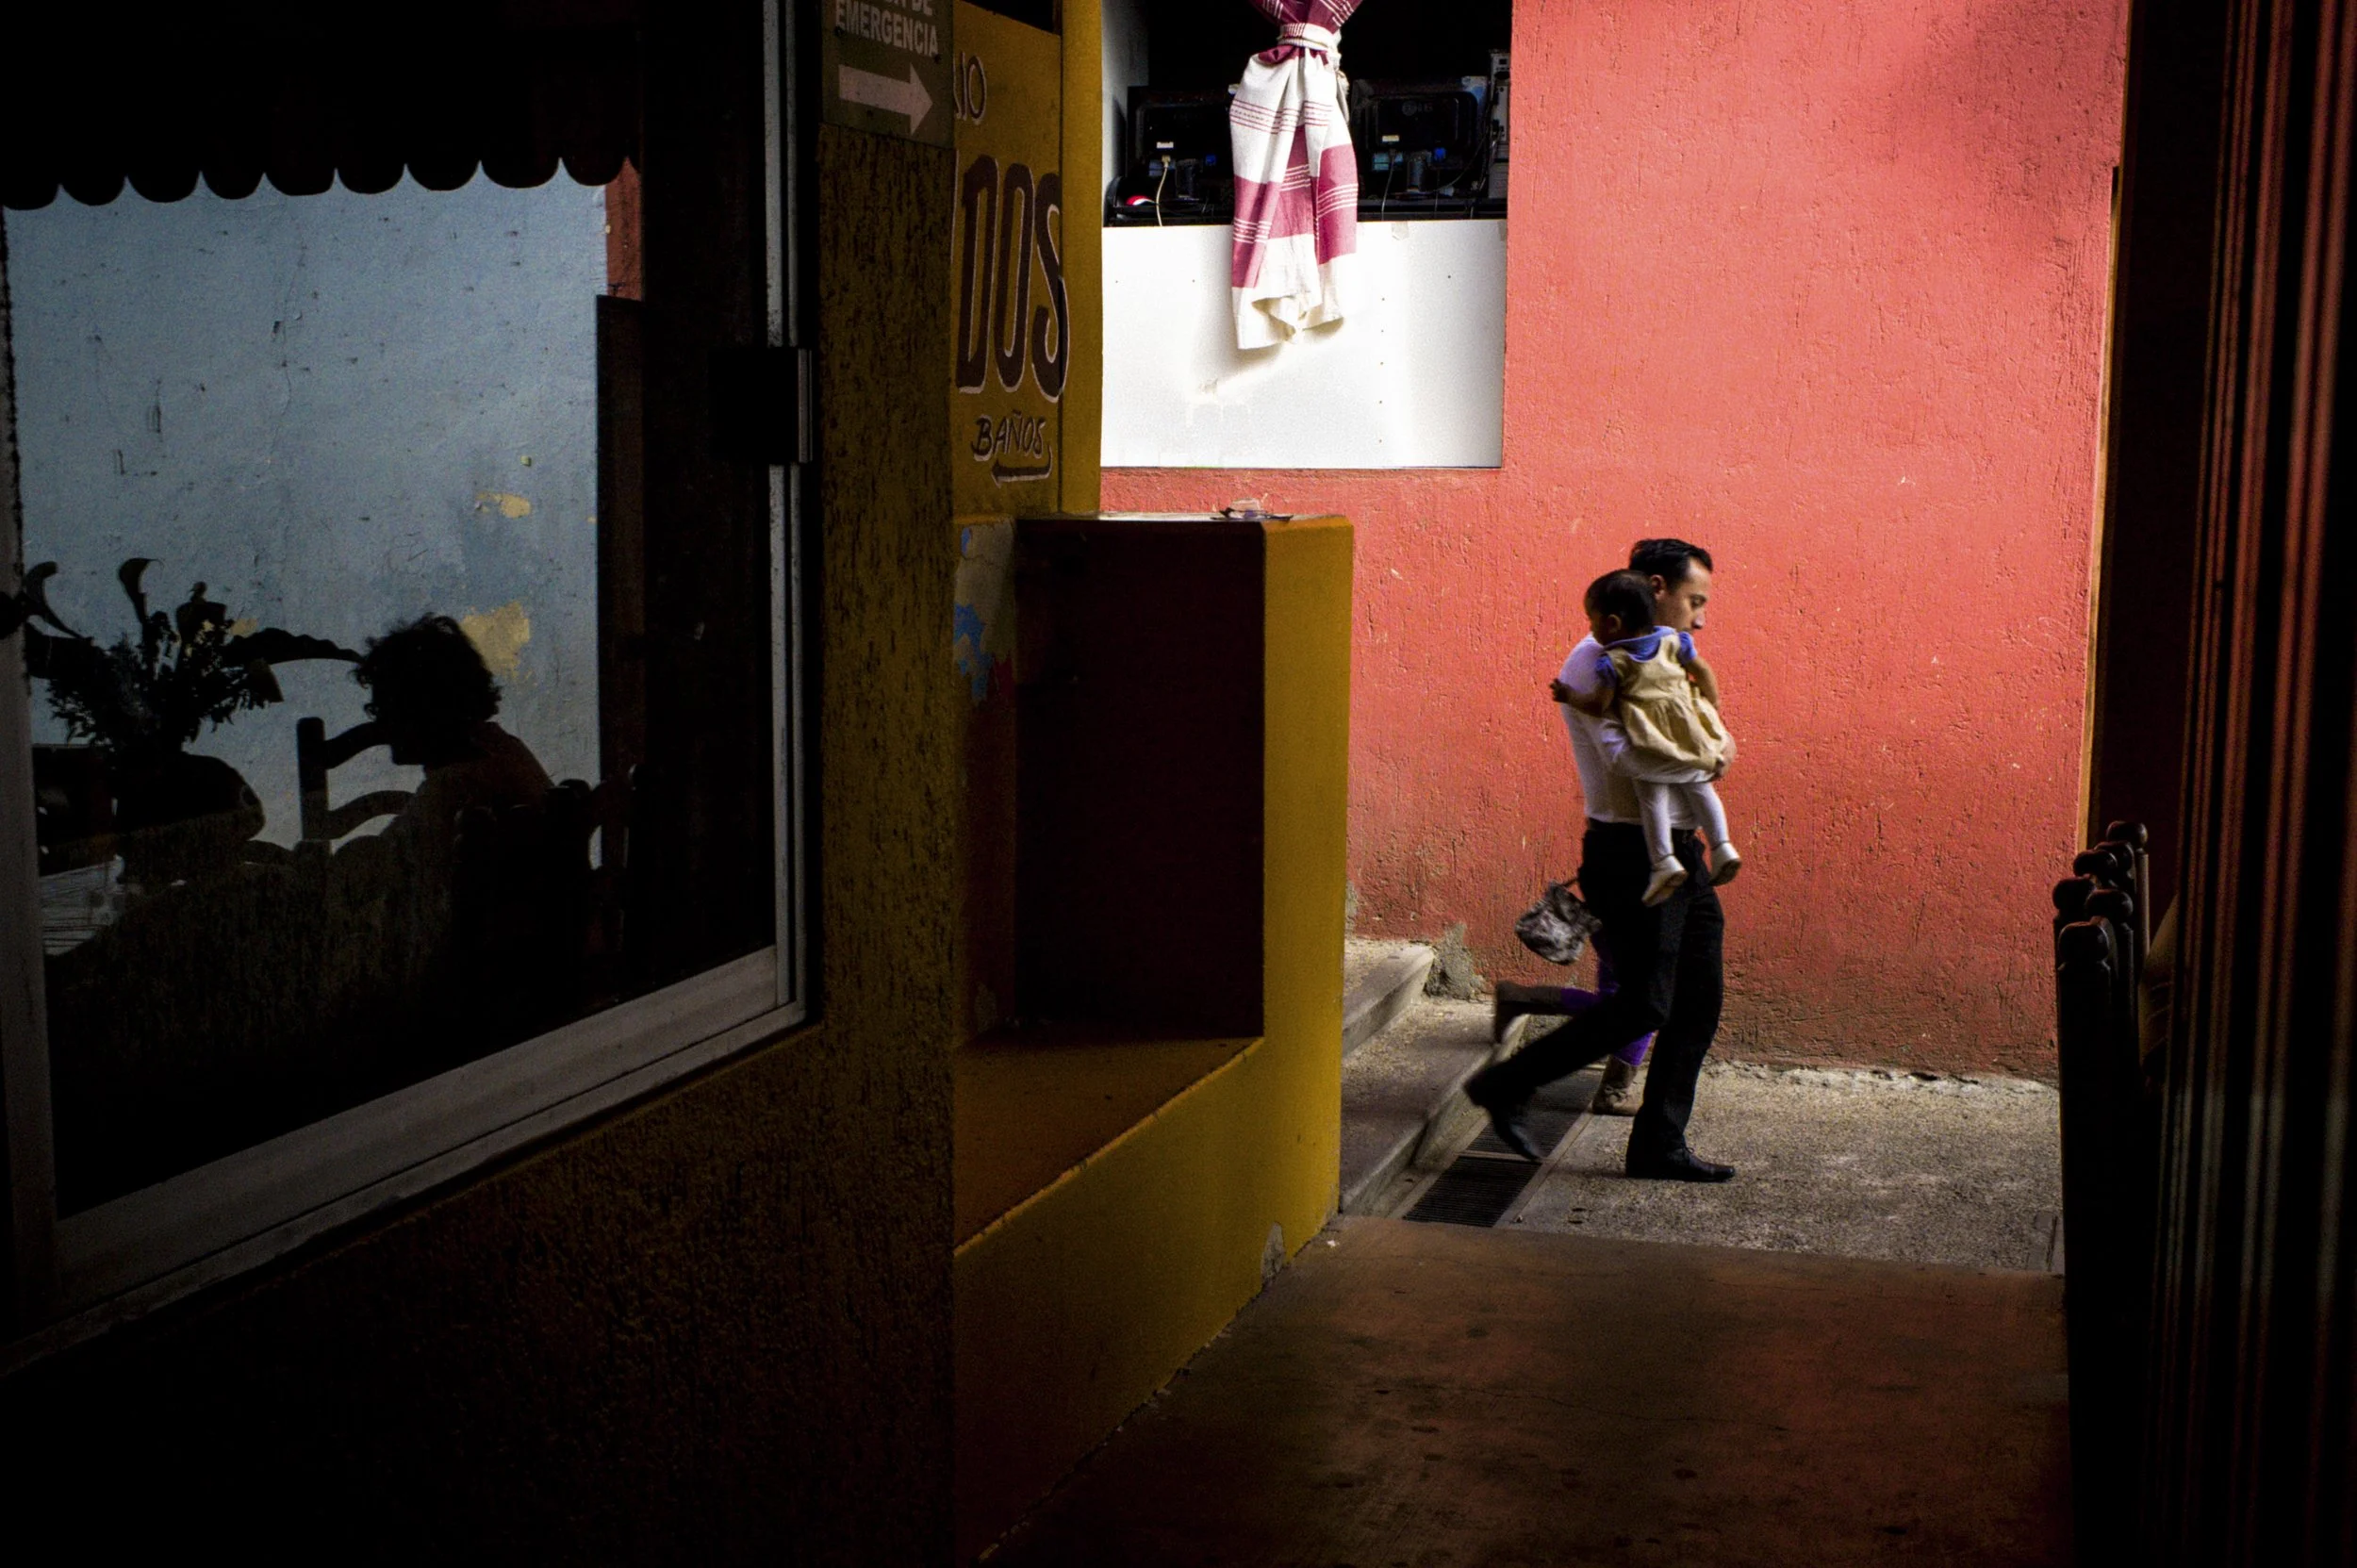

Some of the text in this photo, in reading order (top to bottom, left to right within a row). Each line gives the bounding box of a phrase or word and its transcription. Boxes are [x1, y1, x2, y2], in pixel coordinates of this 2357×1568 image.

[835, 0, 939, 58] EMERGENCIA
[951, 151, 1070, 404] DOS
[970, 409, 1047, 462] BAÑOS
